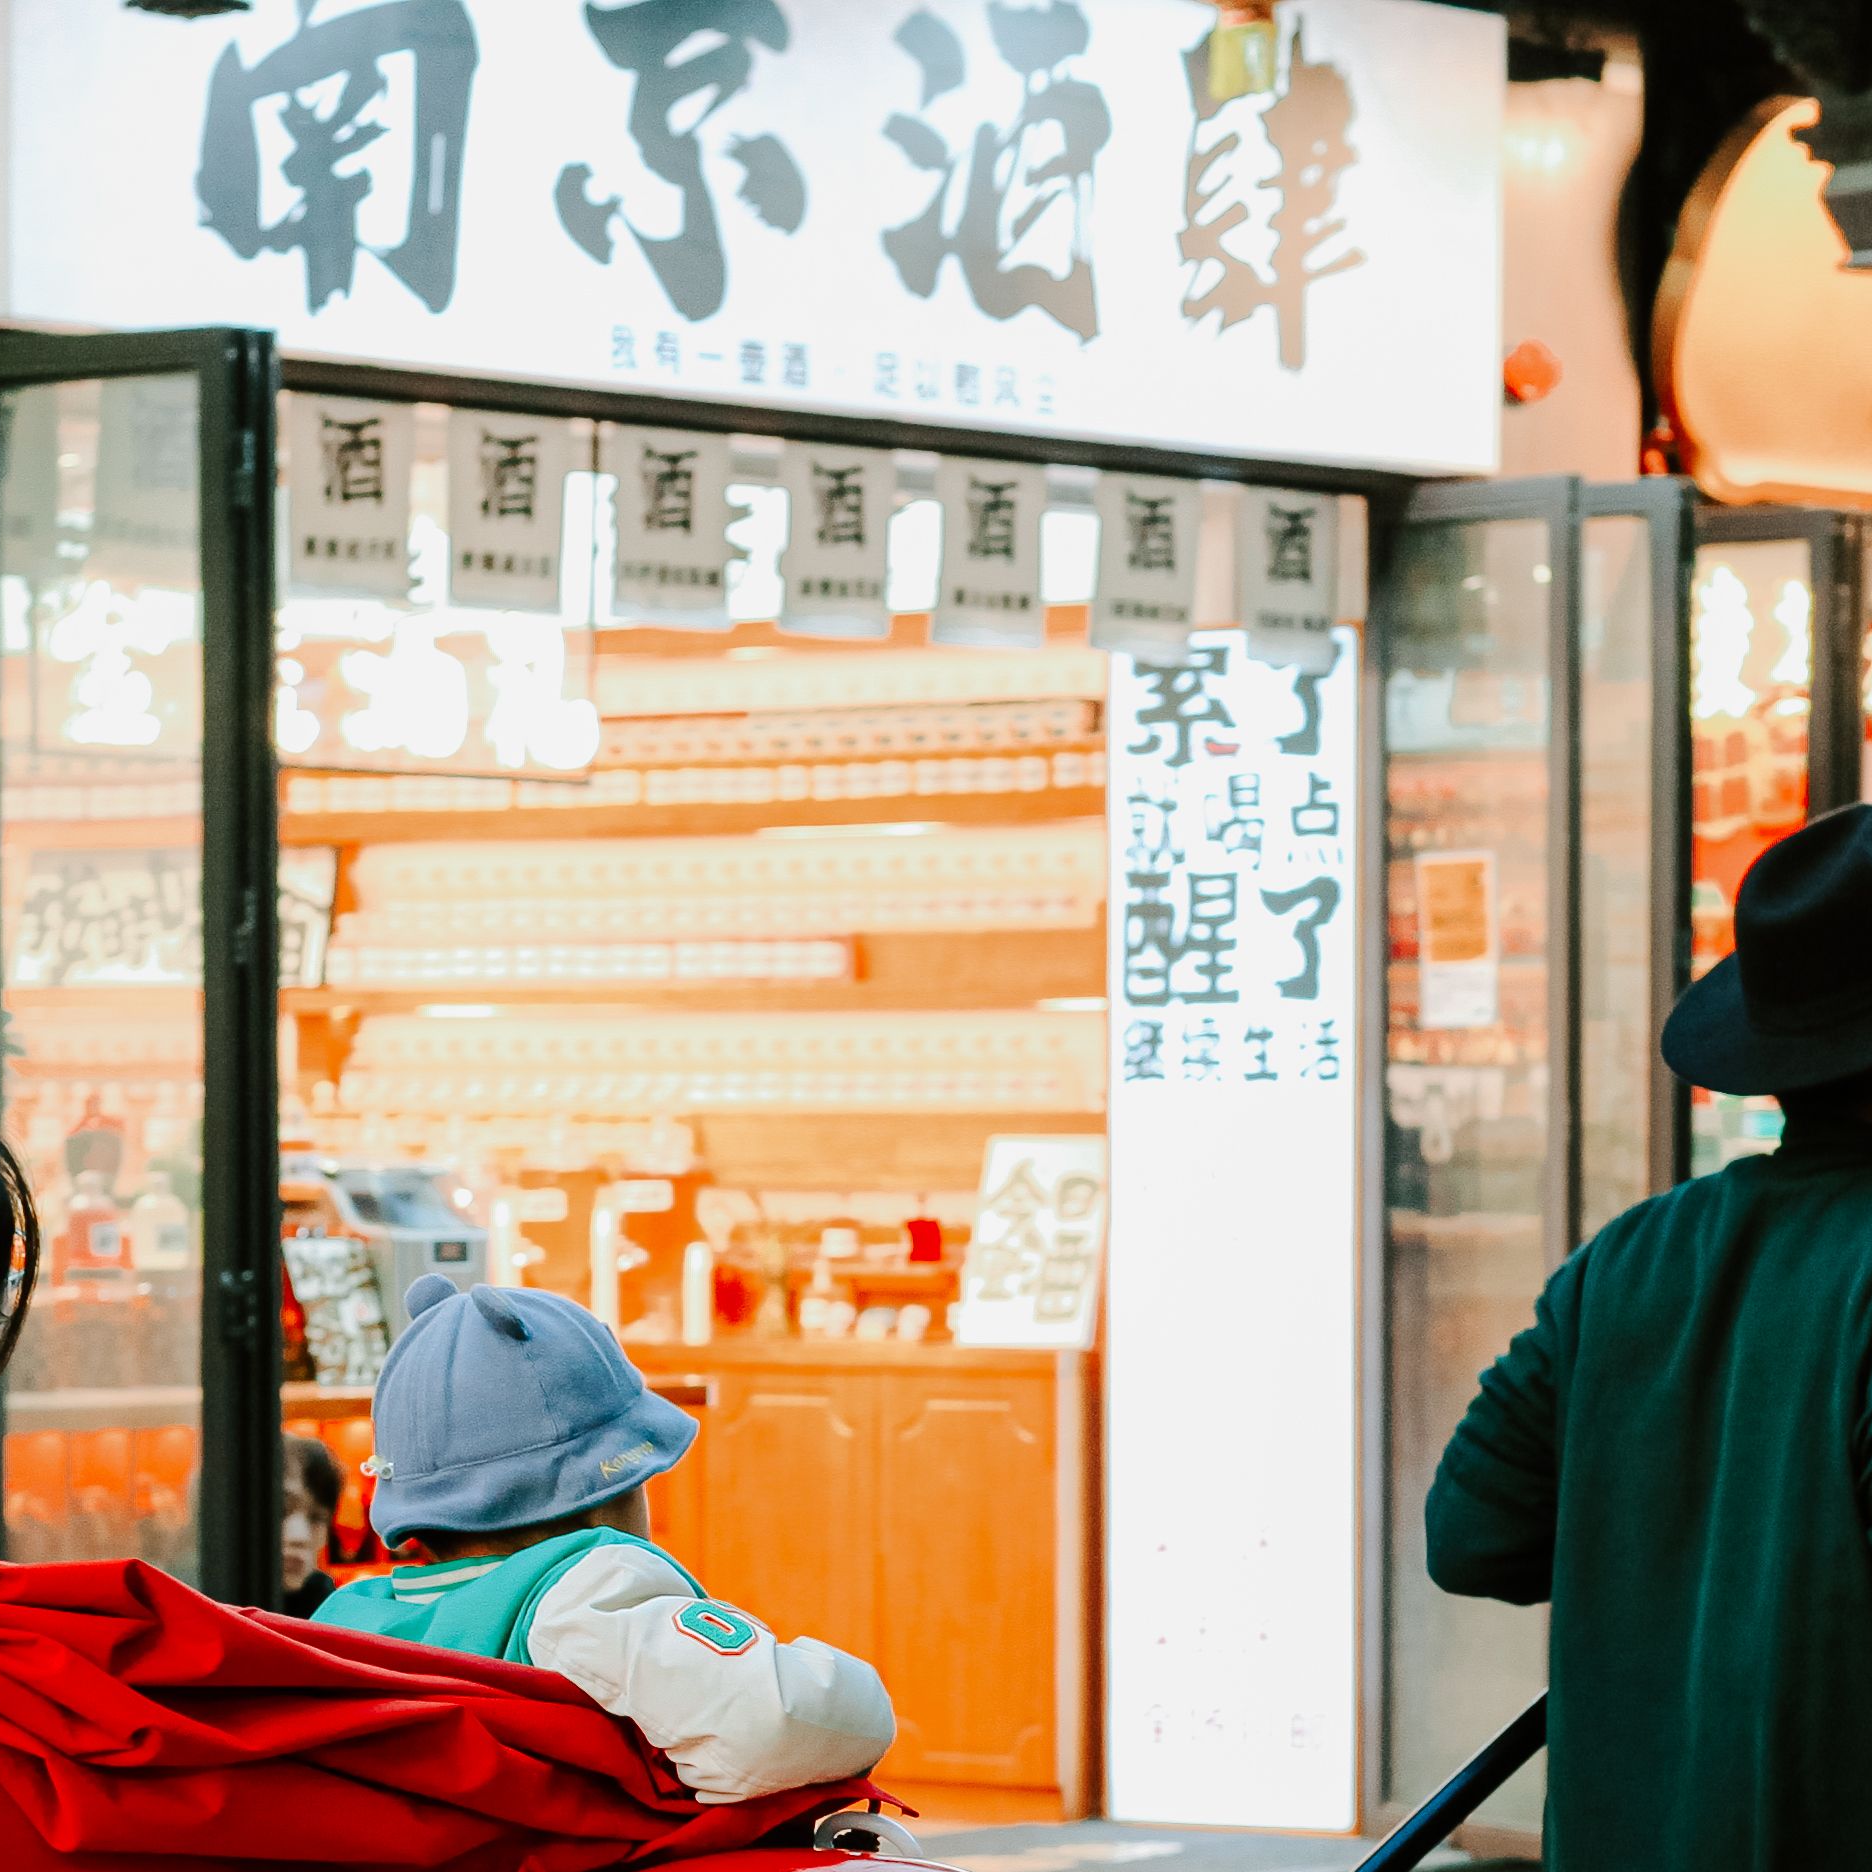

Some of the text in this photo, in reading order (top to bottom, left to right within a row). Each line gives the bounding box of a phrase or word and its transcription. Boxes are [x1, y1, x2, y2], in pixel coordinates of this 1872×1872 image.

[194, 0, 1368, 372] 南京酒肆
[1124, 872, 1342, 1007] 醒了
